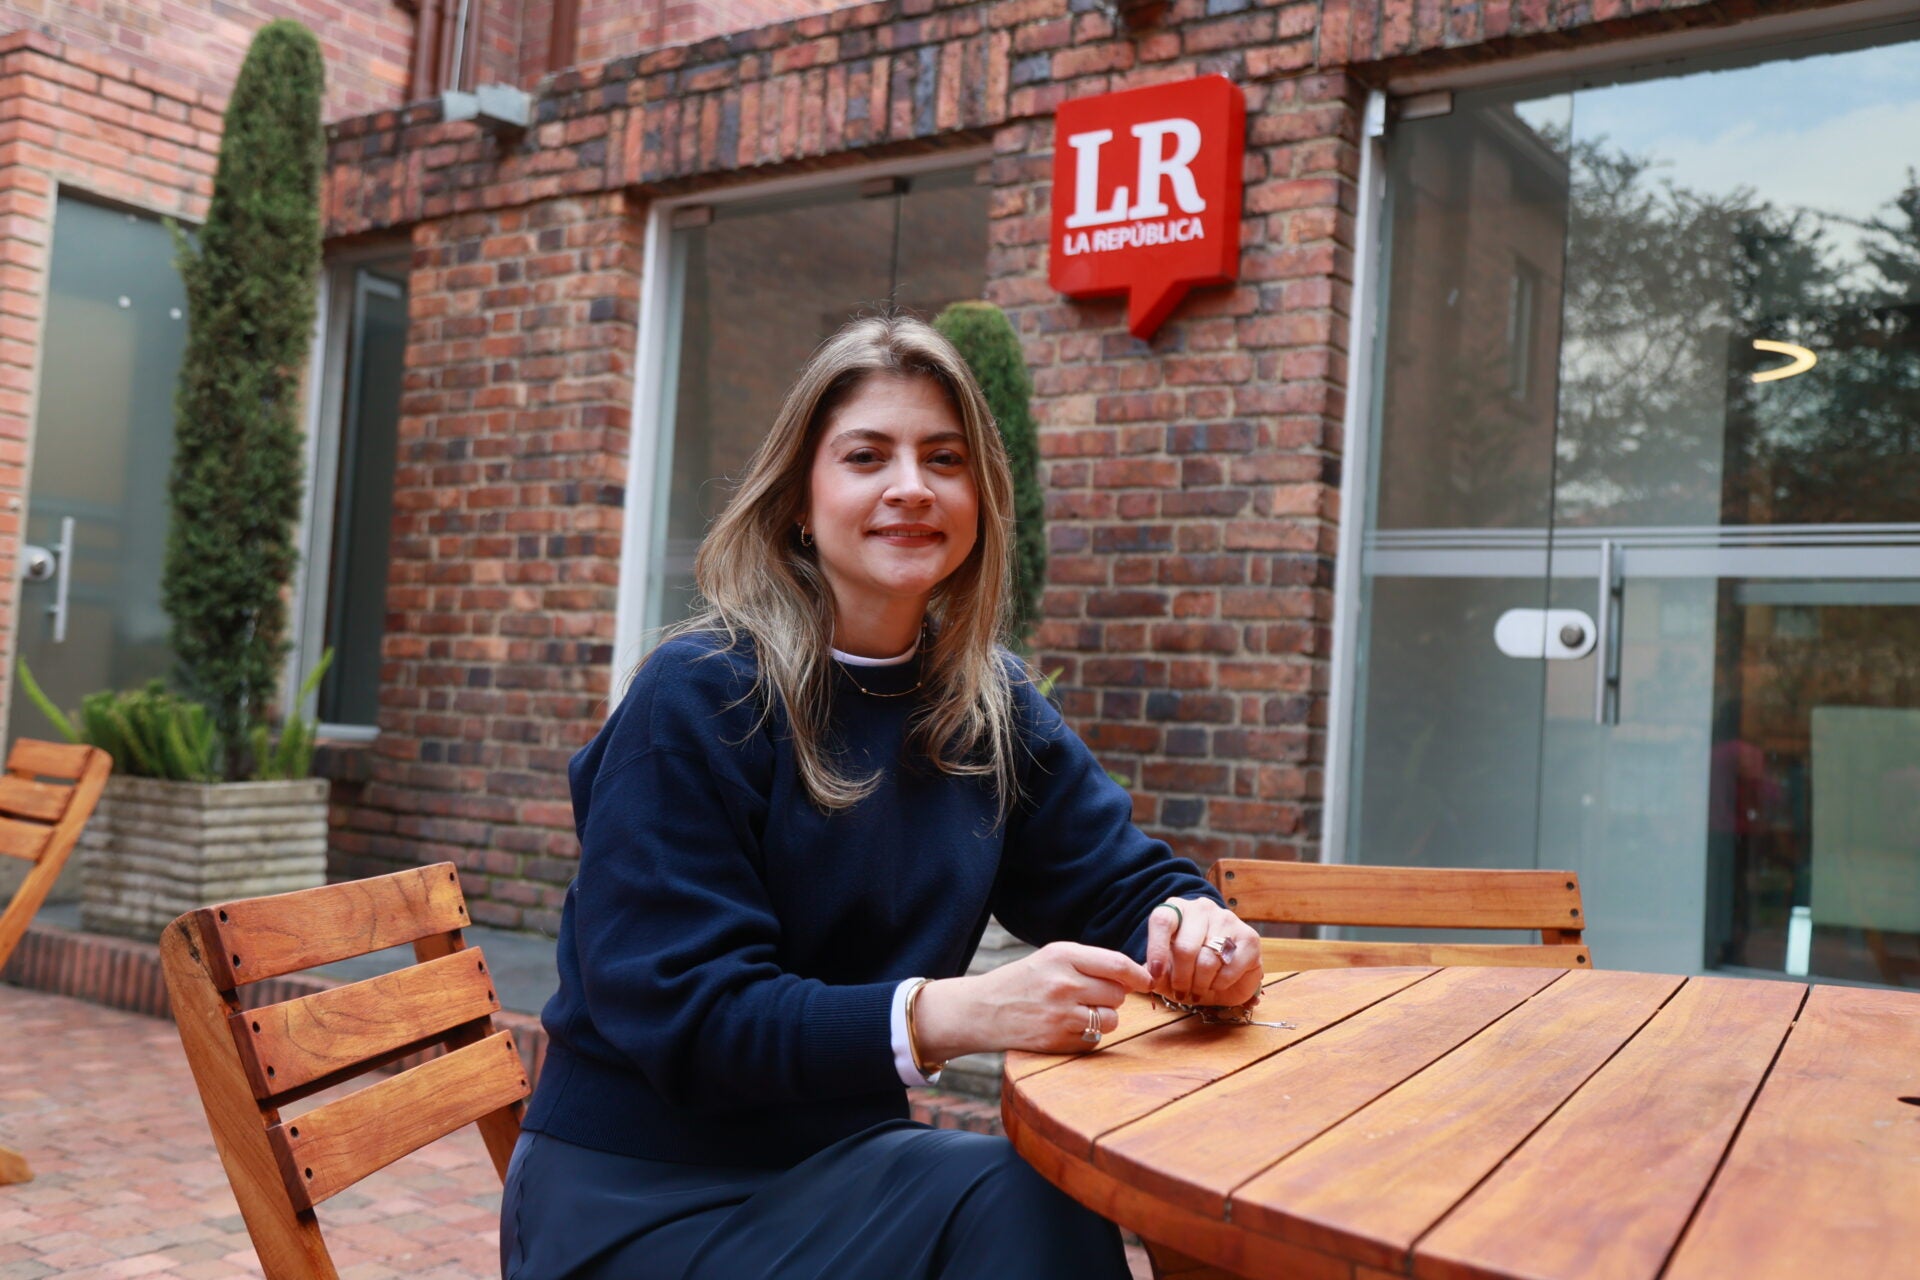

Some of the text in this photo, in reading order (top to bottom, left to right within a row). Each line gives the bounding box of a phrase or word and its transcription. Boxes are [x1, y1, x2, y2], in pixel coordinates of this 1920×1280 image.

[1065, 117, 1206, 229] LR
[1063, 216, 1204, 256] LA REPÚBLICA
